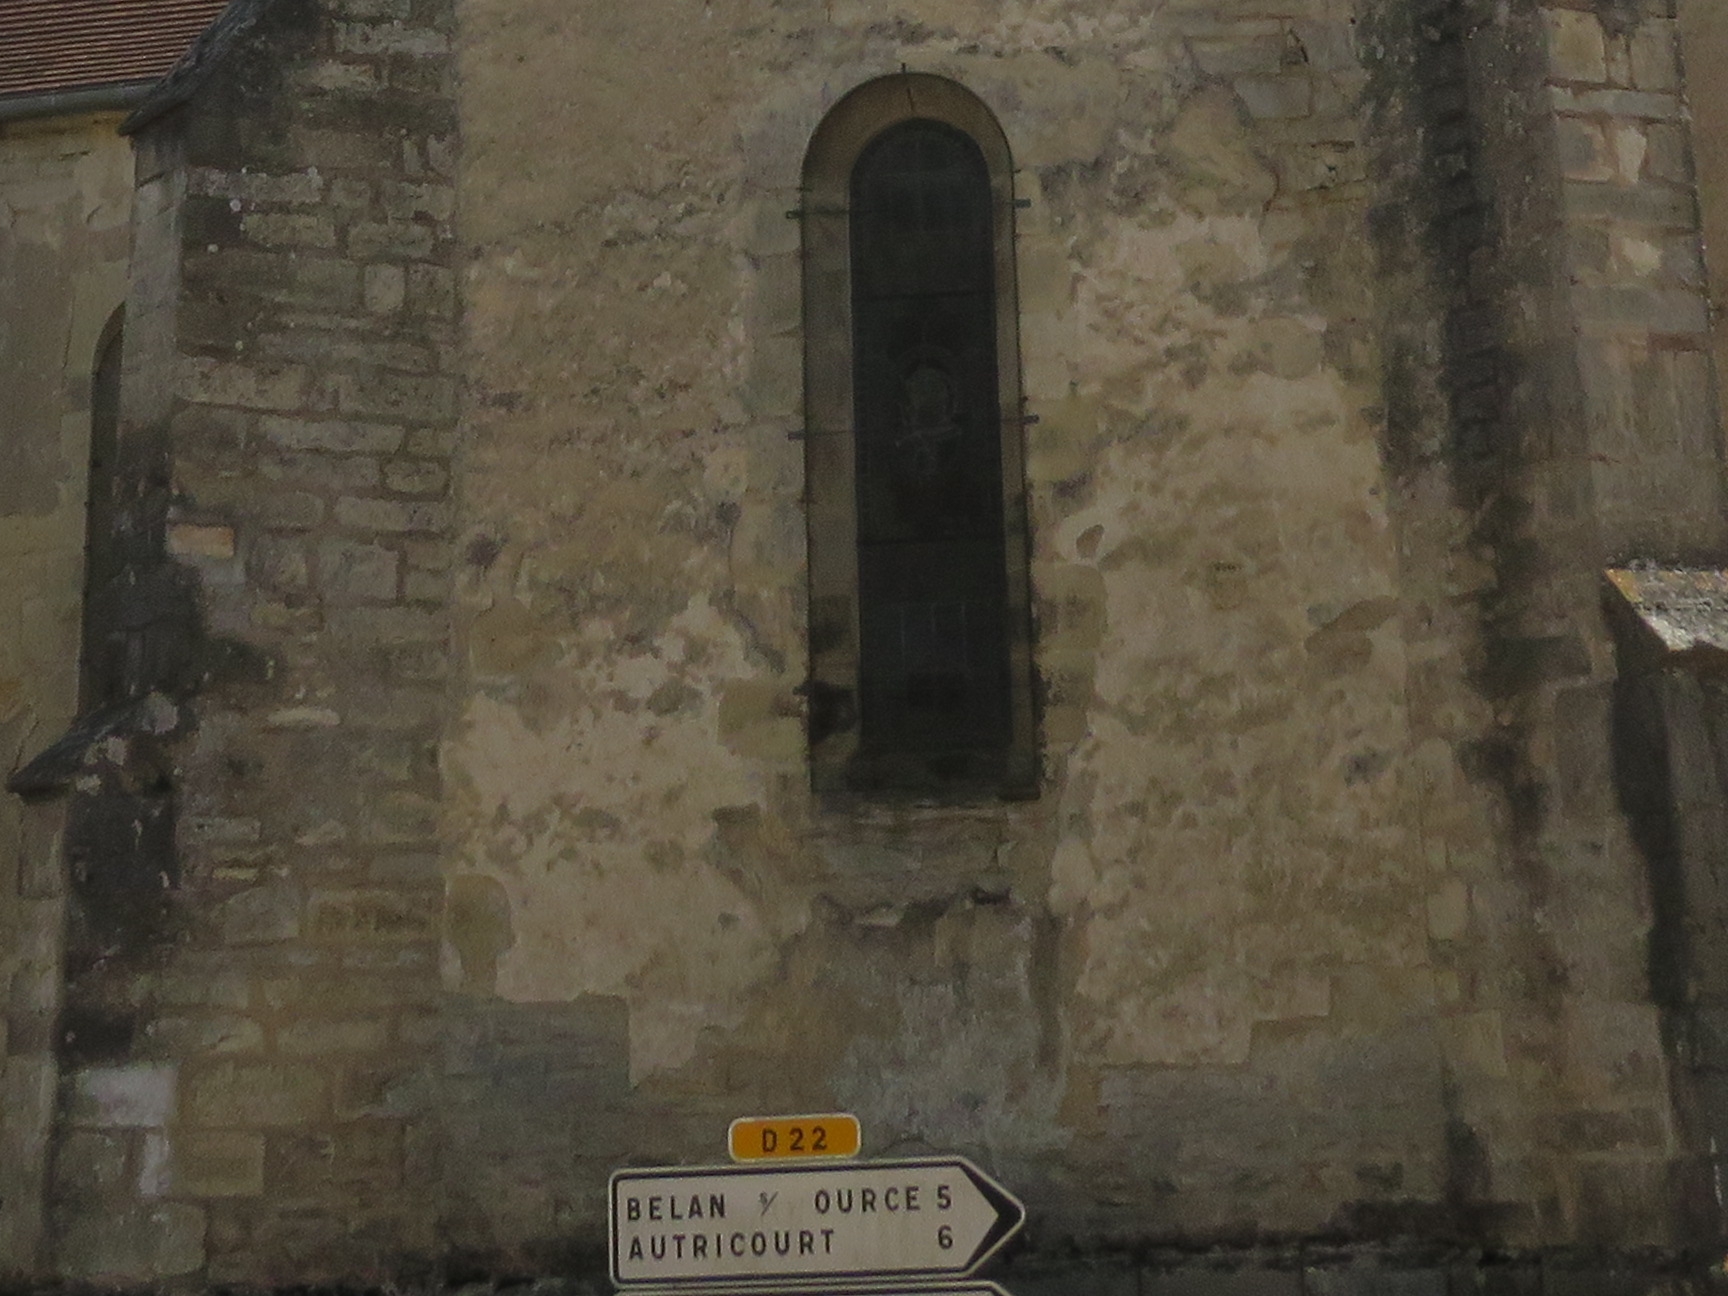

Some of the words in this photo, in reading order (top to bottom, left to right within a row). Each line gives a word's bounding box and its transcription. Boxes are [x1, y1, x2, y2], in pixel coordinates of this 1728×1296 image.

[626, 1193, 726, 1221] BELAN
[814, 1186, 921, 1214] OURCE
[936, 1184, 952, 1210] 5
[628, 1228, 835, 1261] AUTRICOURT
[937, 1224, 954, 1250] 6
